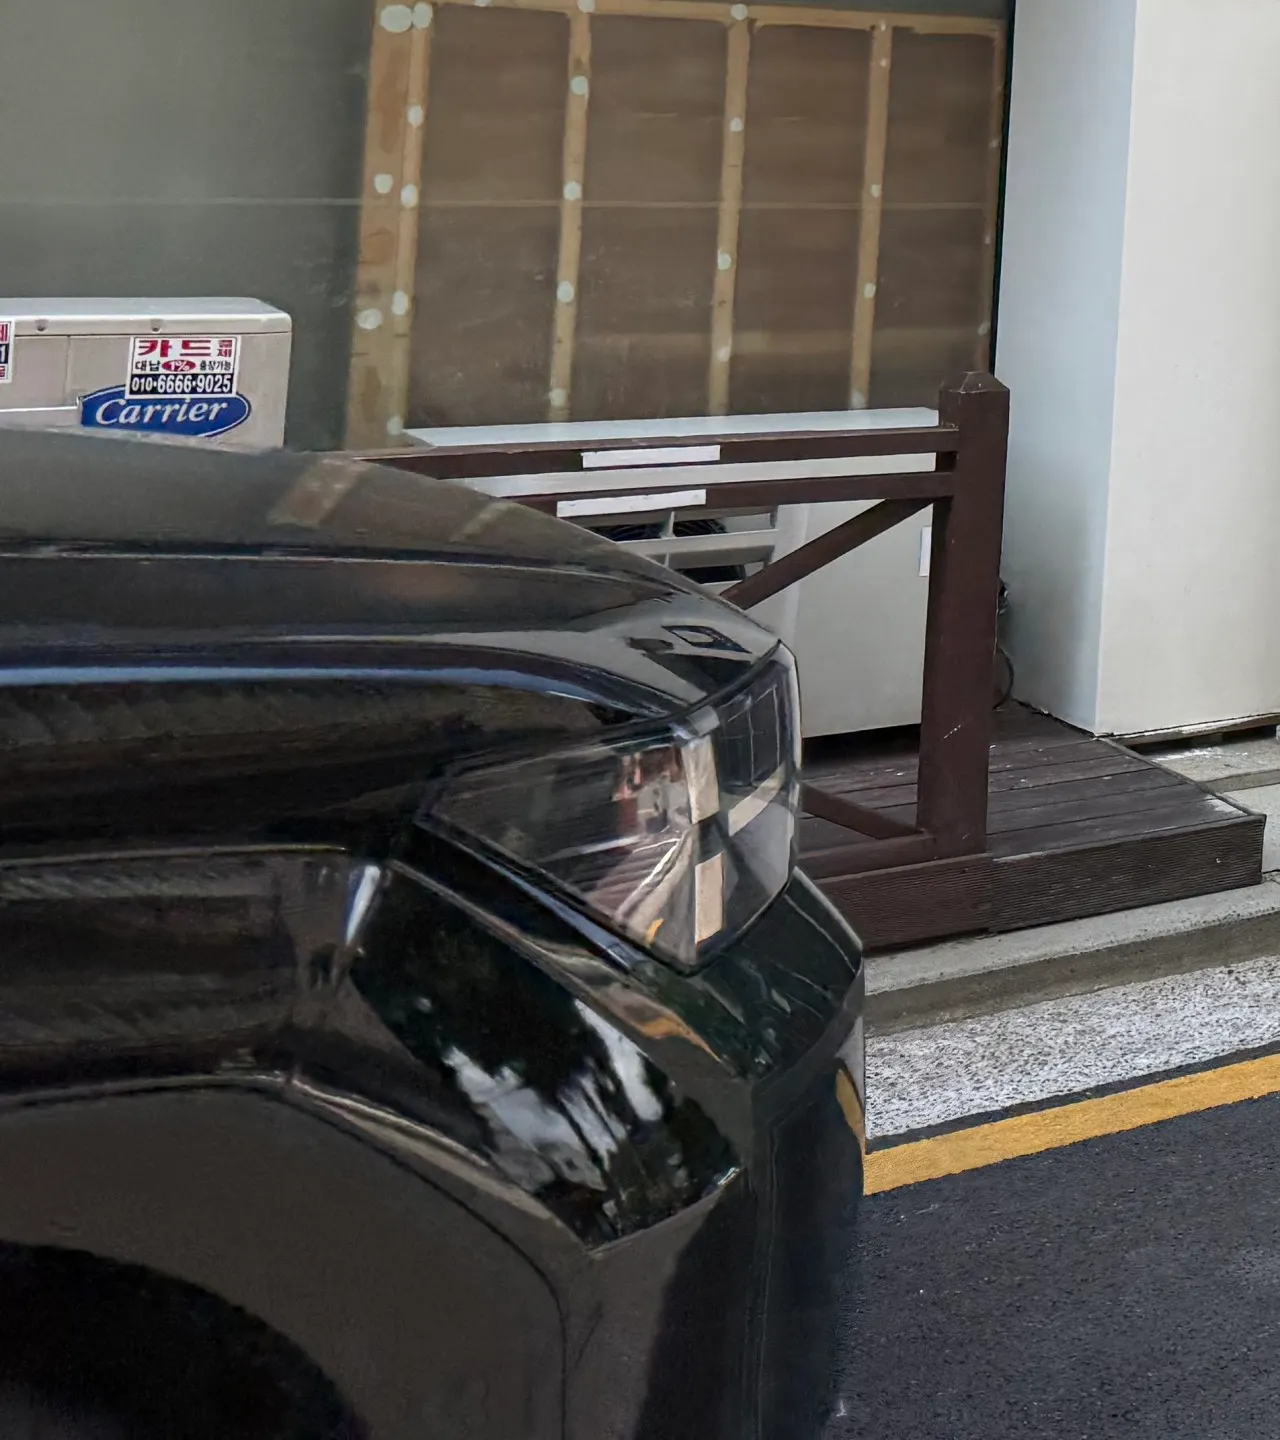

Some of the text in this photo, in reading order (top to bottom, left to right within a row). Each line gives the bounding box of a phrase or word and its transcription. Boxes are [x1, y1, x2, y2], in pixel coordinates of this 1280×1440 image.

[138, 340, 211, 358] 카드
[135, 360, 161, 372] 대납
[168, 360, 191, 372] 1%
[96, 396, 229, 426] Carrier
